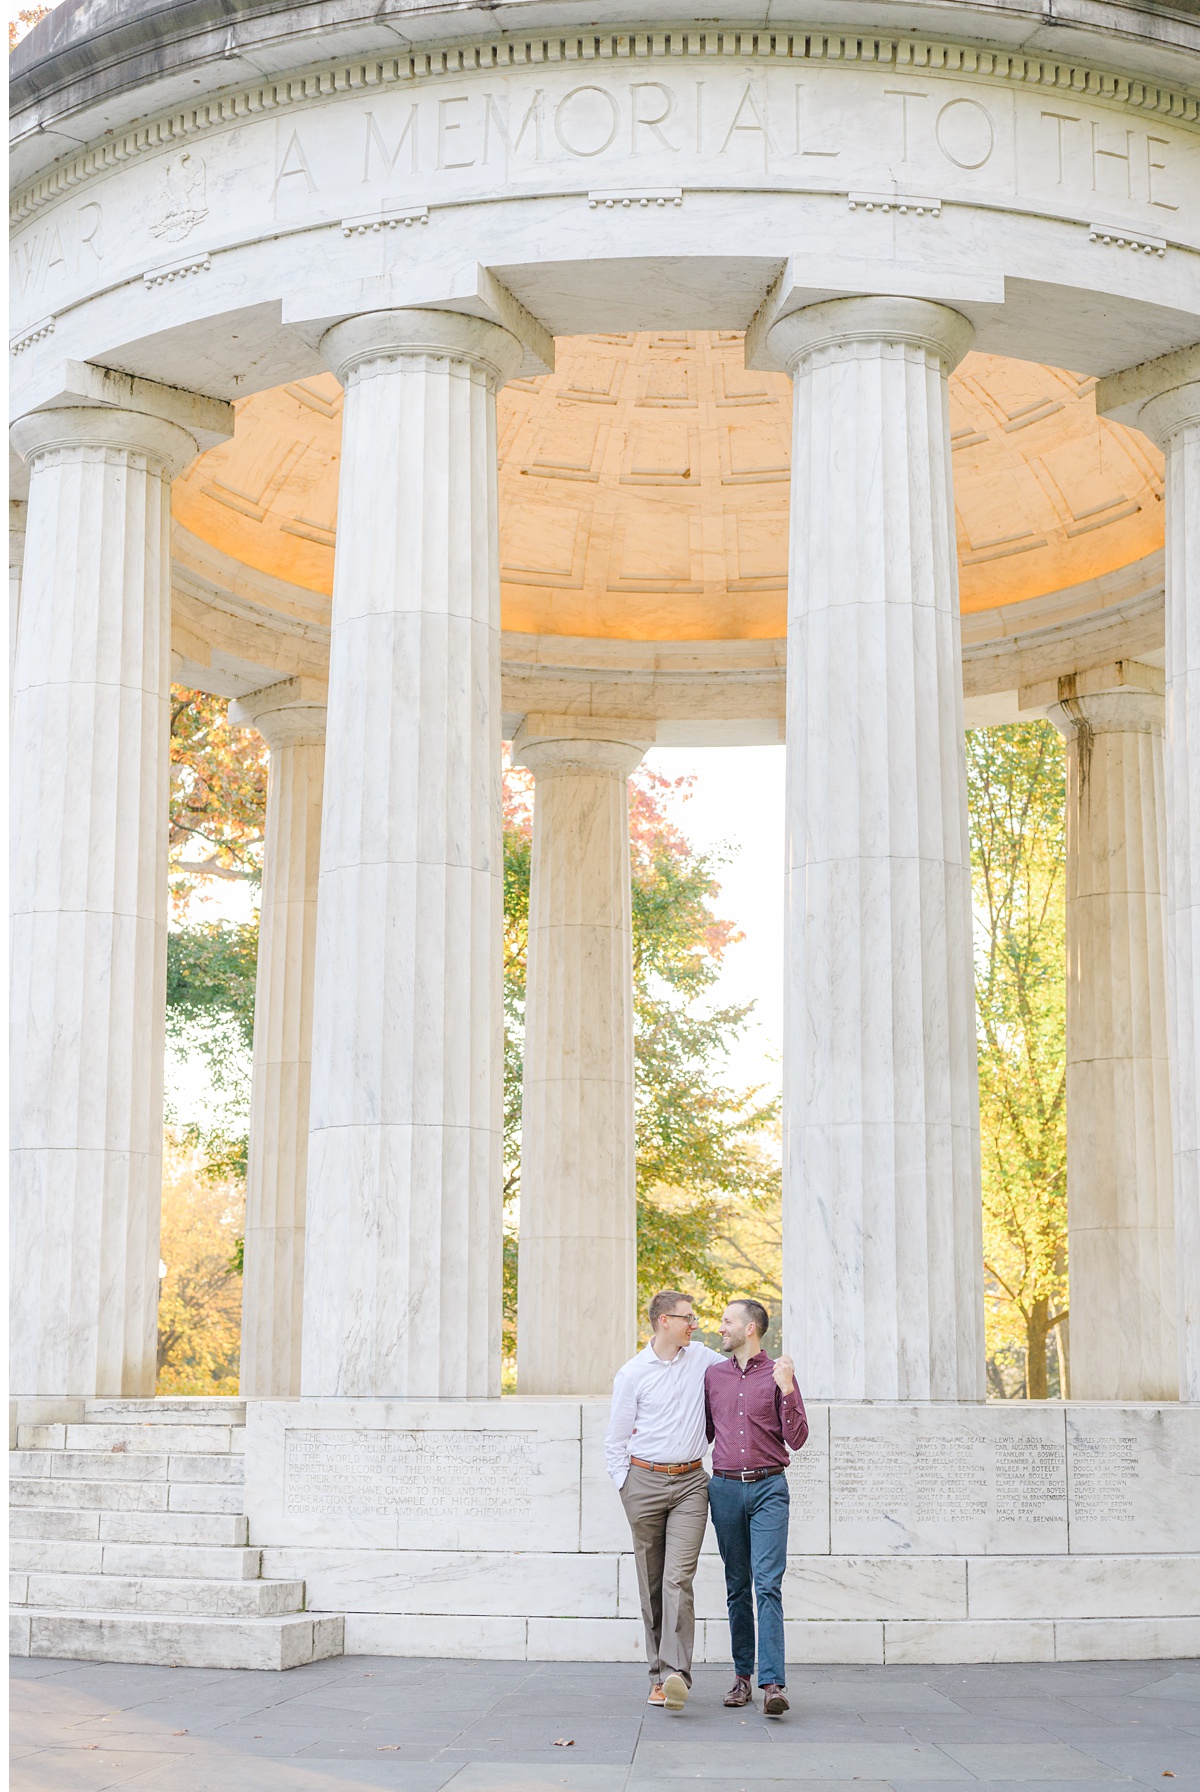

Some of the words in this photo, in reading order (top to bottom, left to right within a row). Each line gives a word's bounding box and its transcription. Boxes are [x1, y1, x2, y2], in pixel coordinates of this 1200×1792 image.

[13, 201, 103, 301] WAR
[269, 127, 319, 203] A
[362, 80, 841, 183] MEMORIAL
[884, 89, 998, 170] TO
[1040, 110, 1180, 211] THE
[305, 1434, 320, 1442] THE
[326, 1434, 354, 1442] NAMES
[359, 1434, 371, 1442] OF
[376, 1434, 391, 1442] THE
[421, 1435, 438, 1443] AND
[443, 1435, 478, 1443] WOMEN
[483, 1435, 508, 1443] FROM
[514, 1435, 530, 1443] THE
[289, 1444, 328, 1453] DISTRICT
[335, 1444, 346, 1453] OF
[407, 1444, 430, 1453] WHO
[437, 1445, 461, 1454] GAVE
[467, 1445, 497, 1454] THEIR
[504, 1445, 532, 1454] LIVES
[289, 1454, 298, 1463] IN
[303, 1454, 320, 1463] THE
[326, 1454, 359, 1463] WORLD
[366, 1454, 386, 1463] WAR
[392, 1454, 409, 1463] ARE
[416, 1456, 439, 1464] HERE
[446, 1456, 501, 1464] INSCRIBED
[508, 1456, 519, 1464] AS
[289, 1464, 340, 1473] PERPETUAL
[346, 1464, 382, 1473] RECORD
[387, 1464, 397, 1473] OF
[406, 1465, 431, 1474] THEIR
[437, 1466, 485, 1474] PATRIOTIC
[491, 1466, 532, 1474] SERVICE
[289, 1474, 300, 1483] TO
[306, 1474, 329, 1483] THEIR
[334, 1474, 372, 1483] COUNTRY
[390, 1475, 418, 1484] THOSE
[423, 1476, 446, 1485] WHO
[451, 1476, 472, 1485] FELL
[479, 1476, 496, 1485] AND
[502, 1476, 531, 1485] THOSE
[289, 1485, 310, 1494] WHO
[314, 1485, 353, 1494] SURVIVED
[359, 1485, 381, 1494] HAVE
[385, 1486, 411, 1495] GIVEN
[416, 1487, 428, 1495] TO
[432, 1487, 451, 1495] THIS
[457, 1487, 474, 1495] AND
[480, 1487, 491, 1495] TO
[497, 1487, 529, 1495] FUTURE
[288, 1495, 352, 1504] GENERATIONS
[378, 1496, 425, 1505] EXAMPLE
[432, 1497, 445, 1506] OF
[452, 1497, 477, 1506] HIGH
[485, 1497, 532, 1506] IDEALISM
[288, 1505, 342, 1515] COURAGEOUS
[348, 1505, 389, 1515] SACRIFICE
[395, 1506, 411, 1516] AND
[417, 1508, 459, 1517] GALLANT
[465, 1508, 531, 1517] ACHIEVEMENT
